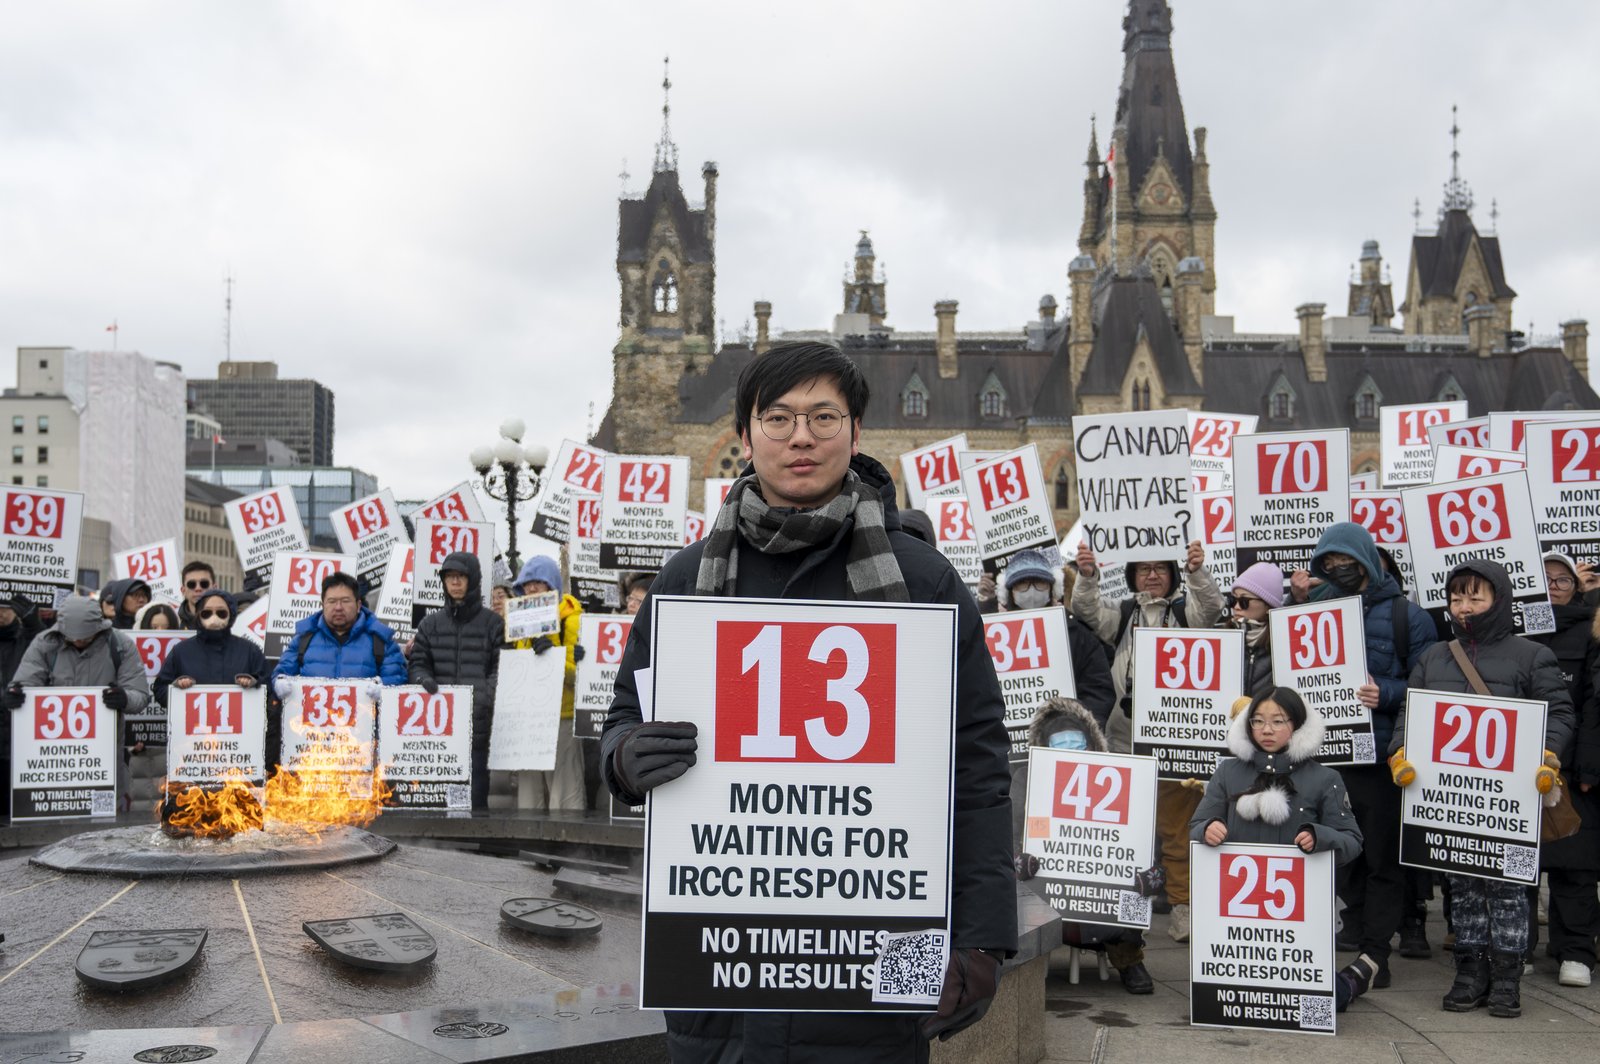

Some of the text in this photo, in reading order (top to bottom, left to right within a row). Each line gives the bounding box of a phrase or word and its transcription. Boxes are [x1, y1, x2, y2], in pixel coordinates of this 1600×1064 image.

[1405, 410, 1442, 445] 19
[1076, 425, 1191, 462] CANADA
[1193, 420, 1234, 457] 23
[567, 452, 602, 490] 27
[920, 447, 950, 489] 27
[1266, 442, 1320, 492] 70
[624, 464, 664, 502] 42
[984, 460, 1021, 508] 13
[1388, 472, 1409, 480] IRCC
[1079, 478, 1142, 512] WHAT
[1145, 477, 1187, 508] ARE
[624, 507, 663, 516] MONTHS
[1264, 498, 1319, 510] MONTHS
[10, 495, 58, 537] 39
[244, 495, 280, 532] 39
[351, 502, 383, 537] 19
[992, 506, 1028, 524] MONTHS
[1251, 512, 1334, 526] WAITING FOR
[1353, 499, 1402, 542] 23
[1438, 487, 1501, 546] 68
[613, 518, 673, 529] WAITING FOR
[985, 515, 1040, 539] WAITING FOR
[1083, 510, 1191, 553] YOU DOING?
[1538, 522, 1568, 534] IRCC
[253, 528, 285, 544] MONTHS
[359, 531, 389, 549] MONTHS
[629, 530, 678, 541] RESPONSE
[984, 526, 1048, 553] IRCC RESPONSE
[1244, 530, 1271, 541] IRCC
[8, 540, 54, 553] MONTHS
[248, 534, 296, 556] WAITING FOR
[615, 546, 626, 555] NO
[1552, 544, 1568, 554] NO
[44, 556, 64, 565] FOR
[246, 555, 263, 566] IRCC
[618, 556, 629, 565] NO
[995, 557, 1007, 568] NO
[1257, 551, 1272, 560] NO
[1445, 546, 1505, 566] MONTHS
[13, 566, 70, 578] RESPONSE
[131, 549, 162, 580] 25
[257, 568, 267, 576] NO
[365, 572, 375, 581] NO
[370, 577, 380, 586] NO
[11, 582, 57, 592] TIMELINES
[0, 592, 12, 600] NO
[419, 591, 438, 600] IRCC
[383, 607, 400, 616] IRCC
[273, 620, 293, 629] IRCC
[388, 622, 399, 632] NO
[987, 619, 1042, 672] 34
[1294, 611, 1339, 668] 30
[1161, 638, 1214, 690] 30
[1297, 673, 1341, 688] MONTHS
[582, 695, 604, 705] IRCC
[740, 624, 870, 761] 13
[1036, 689, 1059, 702] FOR
[1334, 688, 1355, 701] FOR
[308, 687, 352, 726] 35
[1161, 696, 1212, 710] MONTHS
[40, 696, 91, 739] 36
[193, 693, 233, 734] 11
[403, 693, 449, 735] 20
[590, 713, 603, 722] NO
[1148, 710, 1226, 726] WAITING FOR
[132, 723, 144, 732] NO
[1141, 726, 1167, 738] IRCC
[1439, 704, 1508, 769] 20
[40, 745, 88, 756] MONTHS
[193, 741, 239, 751] MONTHS
[403, 741, 447, 751] MONTHS
[182, 754, 251, 763] WAITING FOR
[438, 754, 458, 764] FOR
[1152, 748, 1220, 762] NO TIMELINES
[27, 758, 101, 770] WAITING FOR
[409, 766, 462, 776] RESPONSE
[1157, 760, 1216, 774] NO RESULTS
[20, 770, 108, 783] IRCC RESPONSE
[1439, 772, 1503, 793] MONTHS
[31, 791, 44, 800] NO
[730, 783, 873, 816] MONTHS
[1061, 763, 1122, 822] 42
[35, 801, 92, 812] NO RESULTS
[1422, 788, 1520, 814] WAITING FOR
[1412, 804, 1529, 834] IRCC RESPONSE
[691, 824, 909, 858] WAITING FOR
[1059, 824, 1120, 842] MONTHS
[1425, 832, 1443, 845] NO
[1043, 840, 1135, 861] WAITING FOR
[1430, 847, 1504, 869] NO RESULTS
[668, 865, 927, 900] IRCC RESPONSE
[1046, 883, 1062, 895] NO
[1228, 855, 1296, 920] 25
[1050, 898, 1119, 915] NO RESULTS
[702, 928, 890, 956] NO TIMELINES
[1227, 926, 1295, 943] MONTHS
[1211, 943, 1313, 964] WAITING FOR
[713, 962, 874, 990] NO RESULTS
[1201, 962, 1323, 983] IRCC RESPONSE
[1217, 989, 1236, 1003] NO
[1223, 1005, 1300, 1022] NO RESULTS
